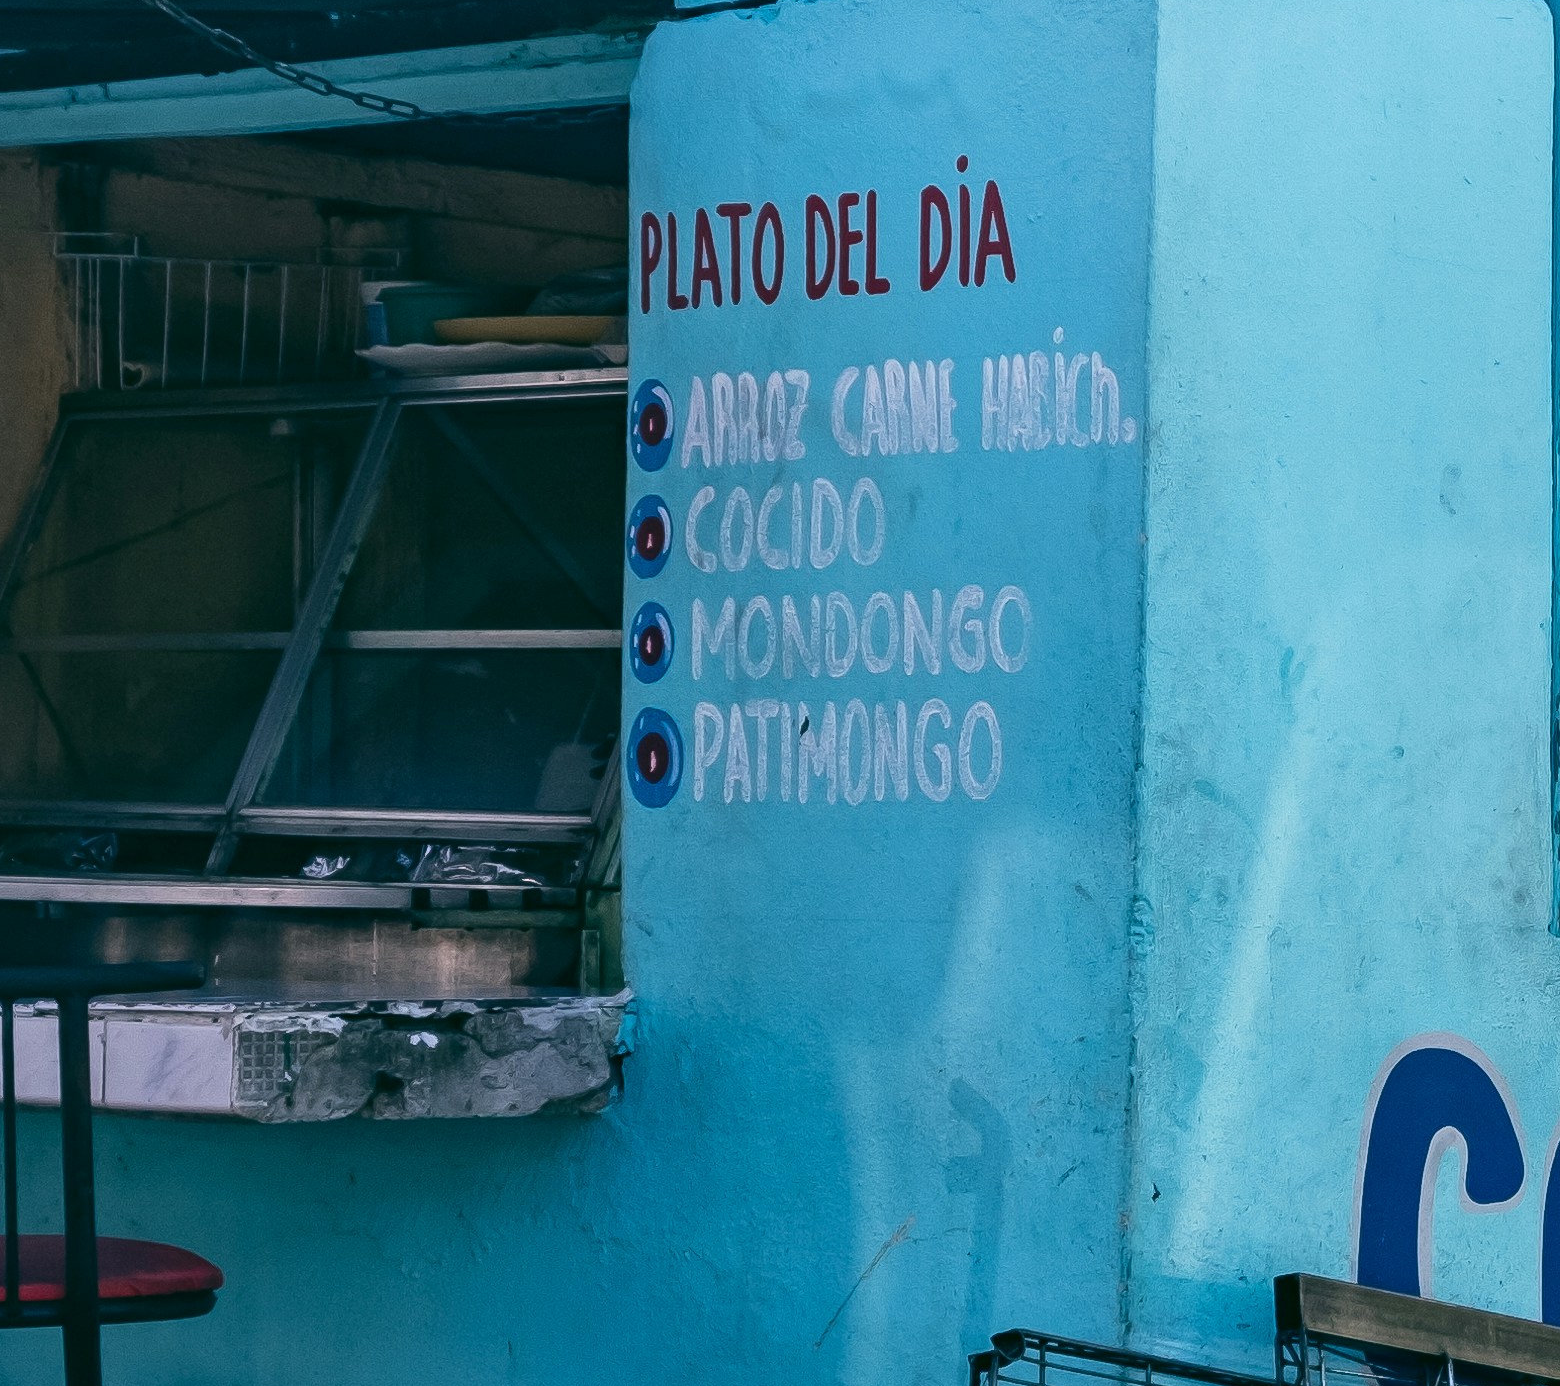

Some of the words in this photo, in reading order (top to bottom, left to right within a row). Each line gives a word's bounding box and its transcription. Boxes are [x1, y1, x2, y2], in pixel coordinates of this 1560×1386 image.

[641, 201, 785, 313] PLATO
[804, 189, 891, 303] DEL
[680, 368, 811, 469] ARROZ
[831, 357, 959, 457] CARNE
[683, 476, 887, 573] COCIDO
[690, 584, 1031, 681] MONDONGO
[692, 697, 1004, 805] PATIMONGO
